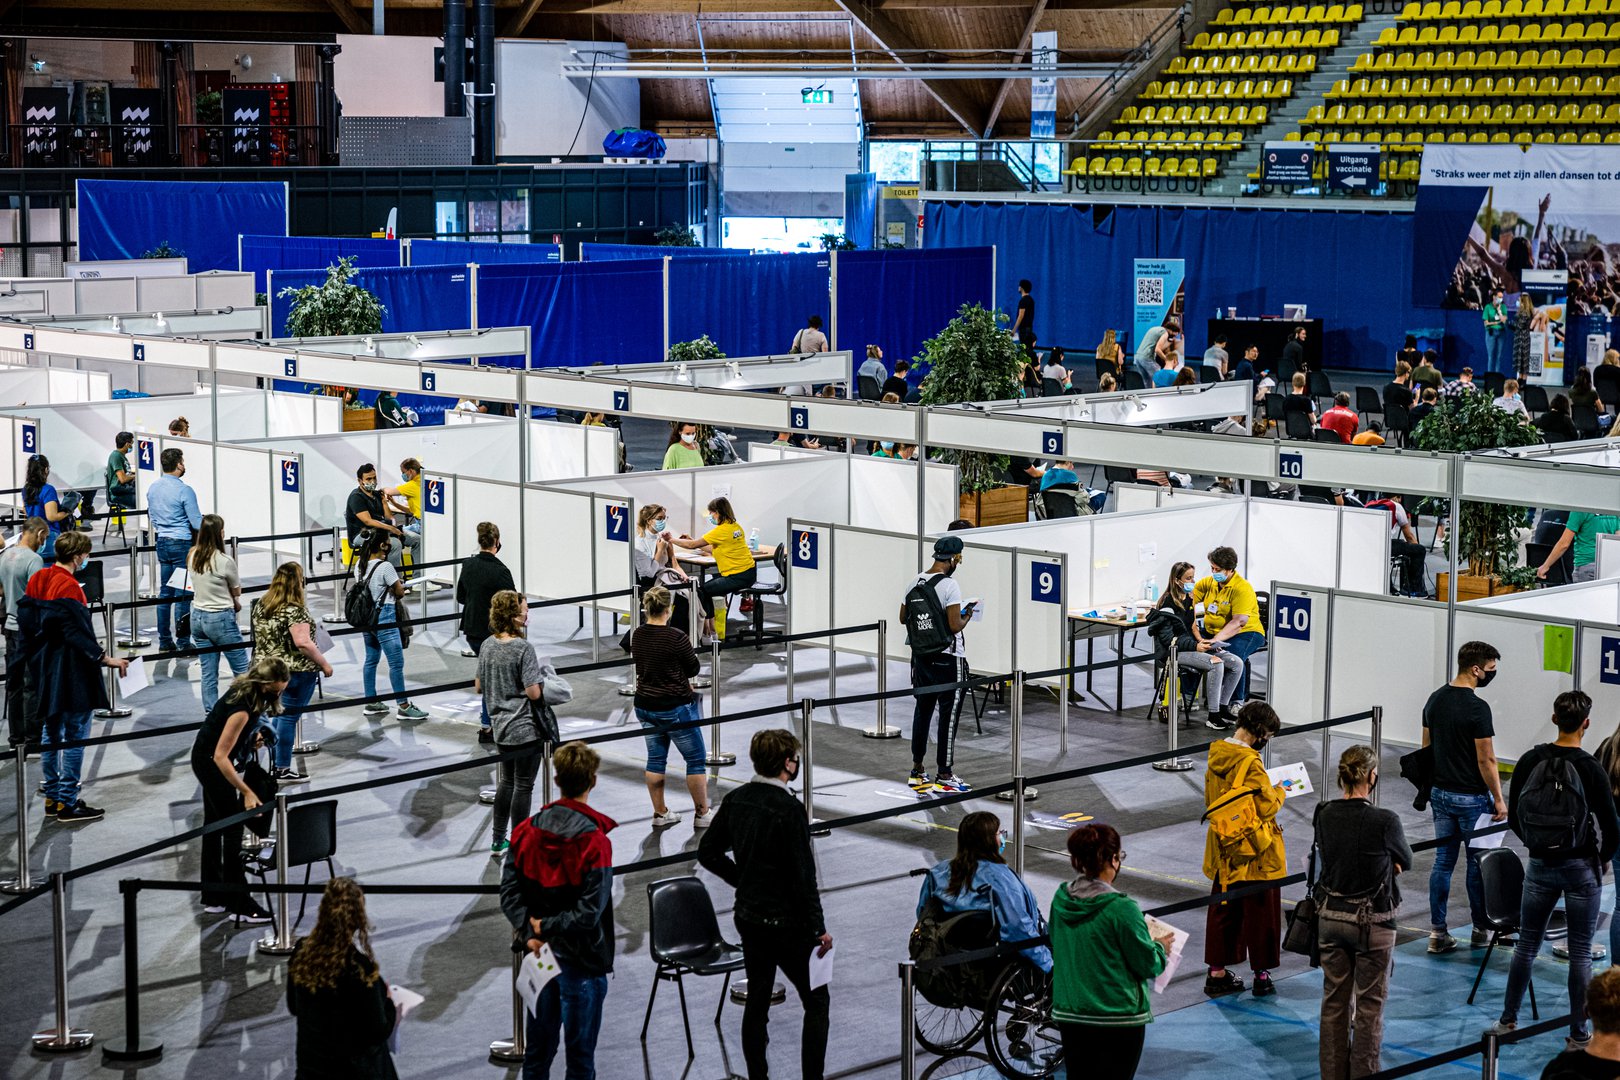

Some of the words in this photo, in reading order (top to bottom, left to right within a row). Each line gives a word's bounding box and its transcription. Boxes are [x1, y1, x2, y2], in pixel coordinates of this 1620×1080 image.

[1340, 155, 1368, 165] Uitgang
[1493, 170, 1511, 178] met
[1513, 169, 1531, 181] zijn
[1533, 169, 1557, 179] allen
[1559, 170, 1594, 180] dansen
[1597, 171, 1611, 180] tot
[26, 337, 32, 349] 3
[136, 348, 143, 360] 4
[287, 363, 294, 375] 5
[425, 378, 433, 390] 6
[617, 397, 625, 408] 7
[796, 413, 804, 427] 8
[25, 431, 34, 448] 3
[1048, 439, 1058, 453] 9
[141, 449, 151, 465] 4
[1281, 460, 1300, 477] 10
[286, 468, 296, 486] 5
[429, 487, 440, 507] 6
[612, 512, 623, 533] 7
[799, 538, 811, 561] 8
[1039, 572, 1053, 595] 9
[1278, 606, 1309, 630] 10
